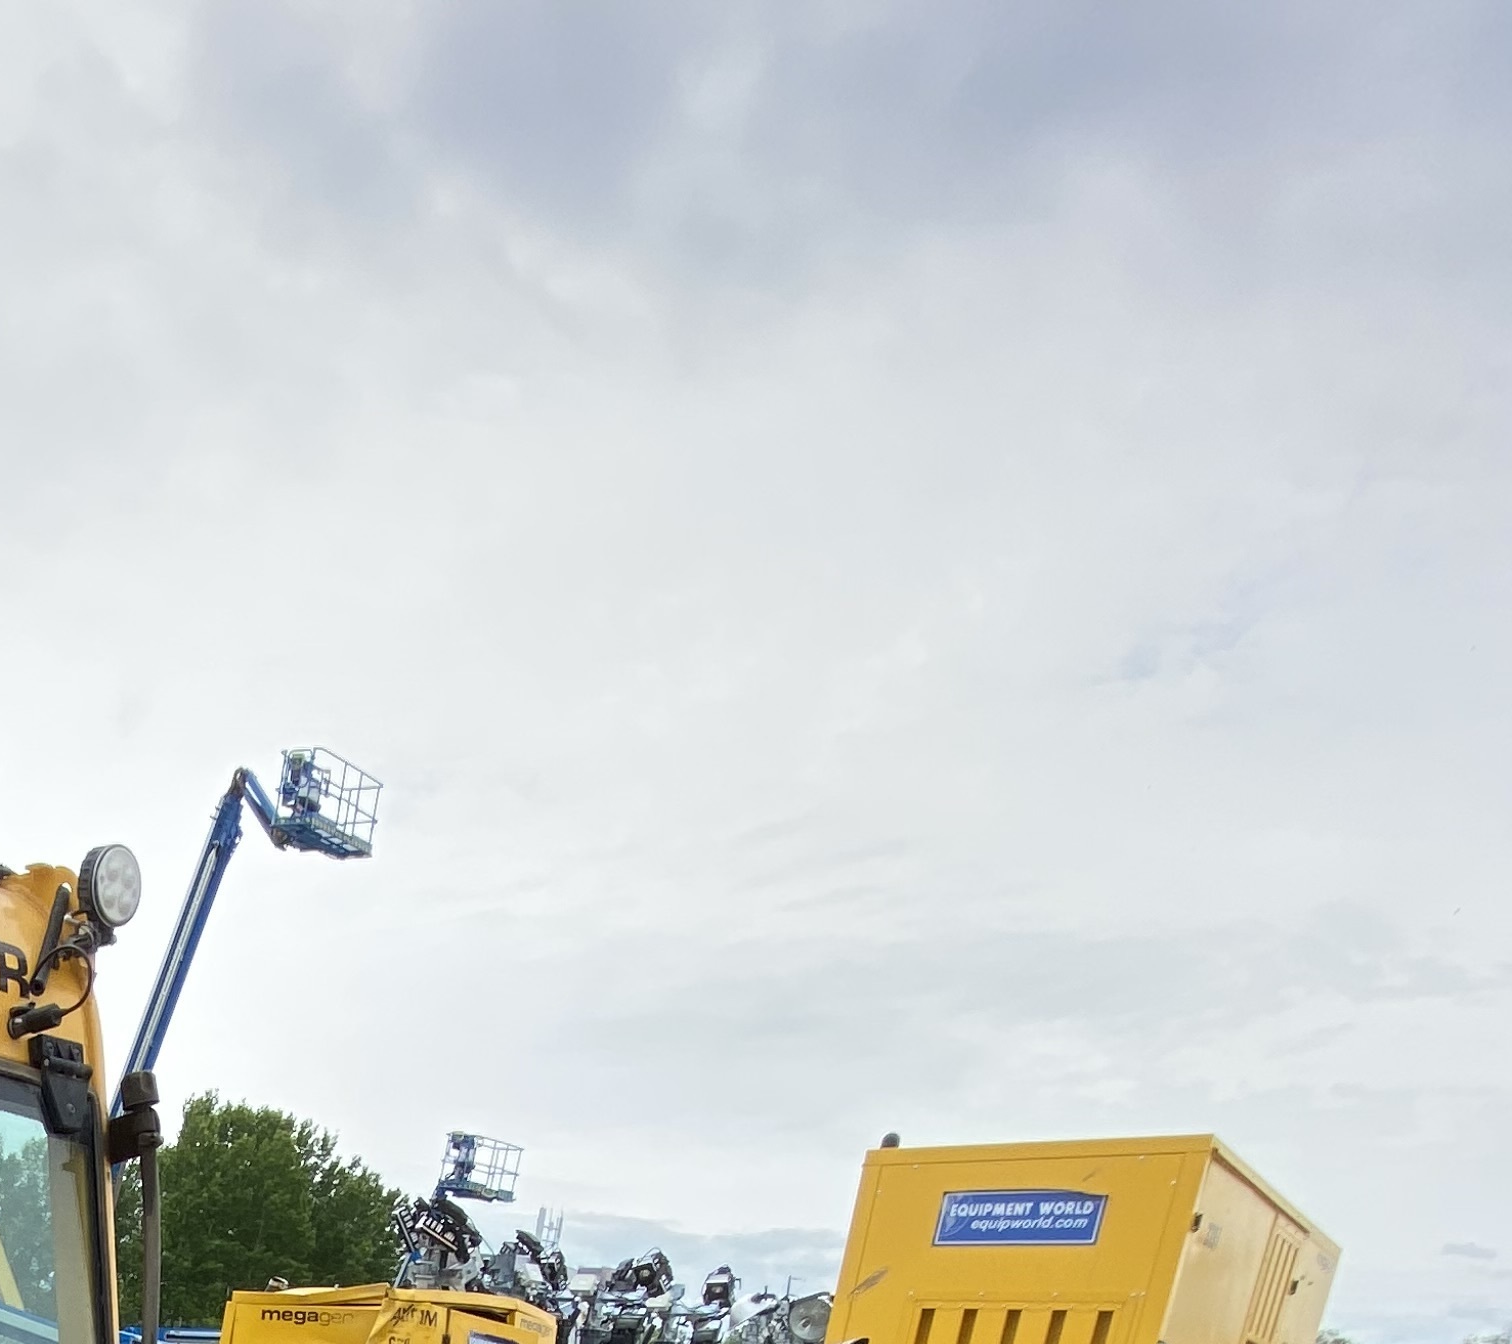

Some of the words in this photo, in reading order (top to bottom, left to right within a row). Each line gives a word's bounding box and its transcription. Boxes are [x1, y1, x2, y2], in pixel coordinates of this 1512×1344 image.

[949, 1202, 1034, 1218] EQUIPMENT
[1039, 1200, 1095, 1216] WORLD
[970, 1216, 1088, 1232] equipworld.com
[261, 1309, 354, 1326] megagen
